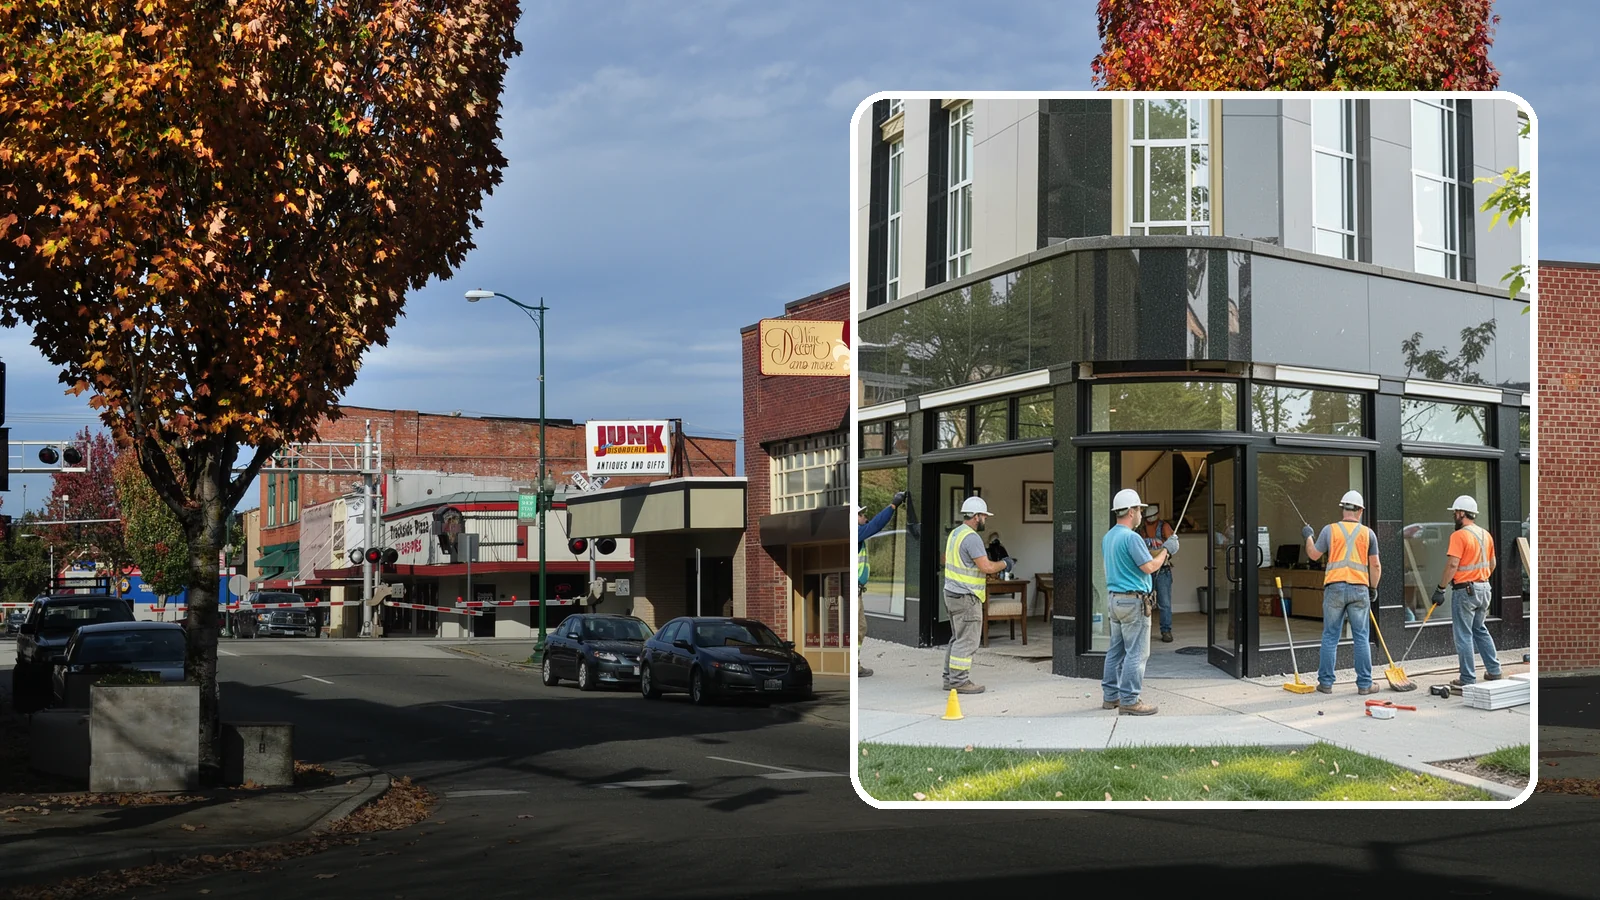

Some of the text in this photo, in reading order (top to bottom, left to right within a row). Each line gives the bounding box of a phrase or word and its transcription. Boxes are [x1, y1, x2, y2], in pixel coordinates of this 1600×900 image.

[765, 327, 831, 365] Decor
[596, 425, 665, 457] JUNK
[607, 446, 646, 454] DISORDERLY
[596, 460, 665, 470] ANTIQUES AND GIFTS
[414, 519, 429, 535] Pizza
